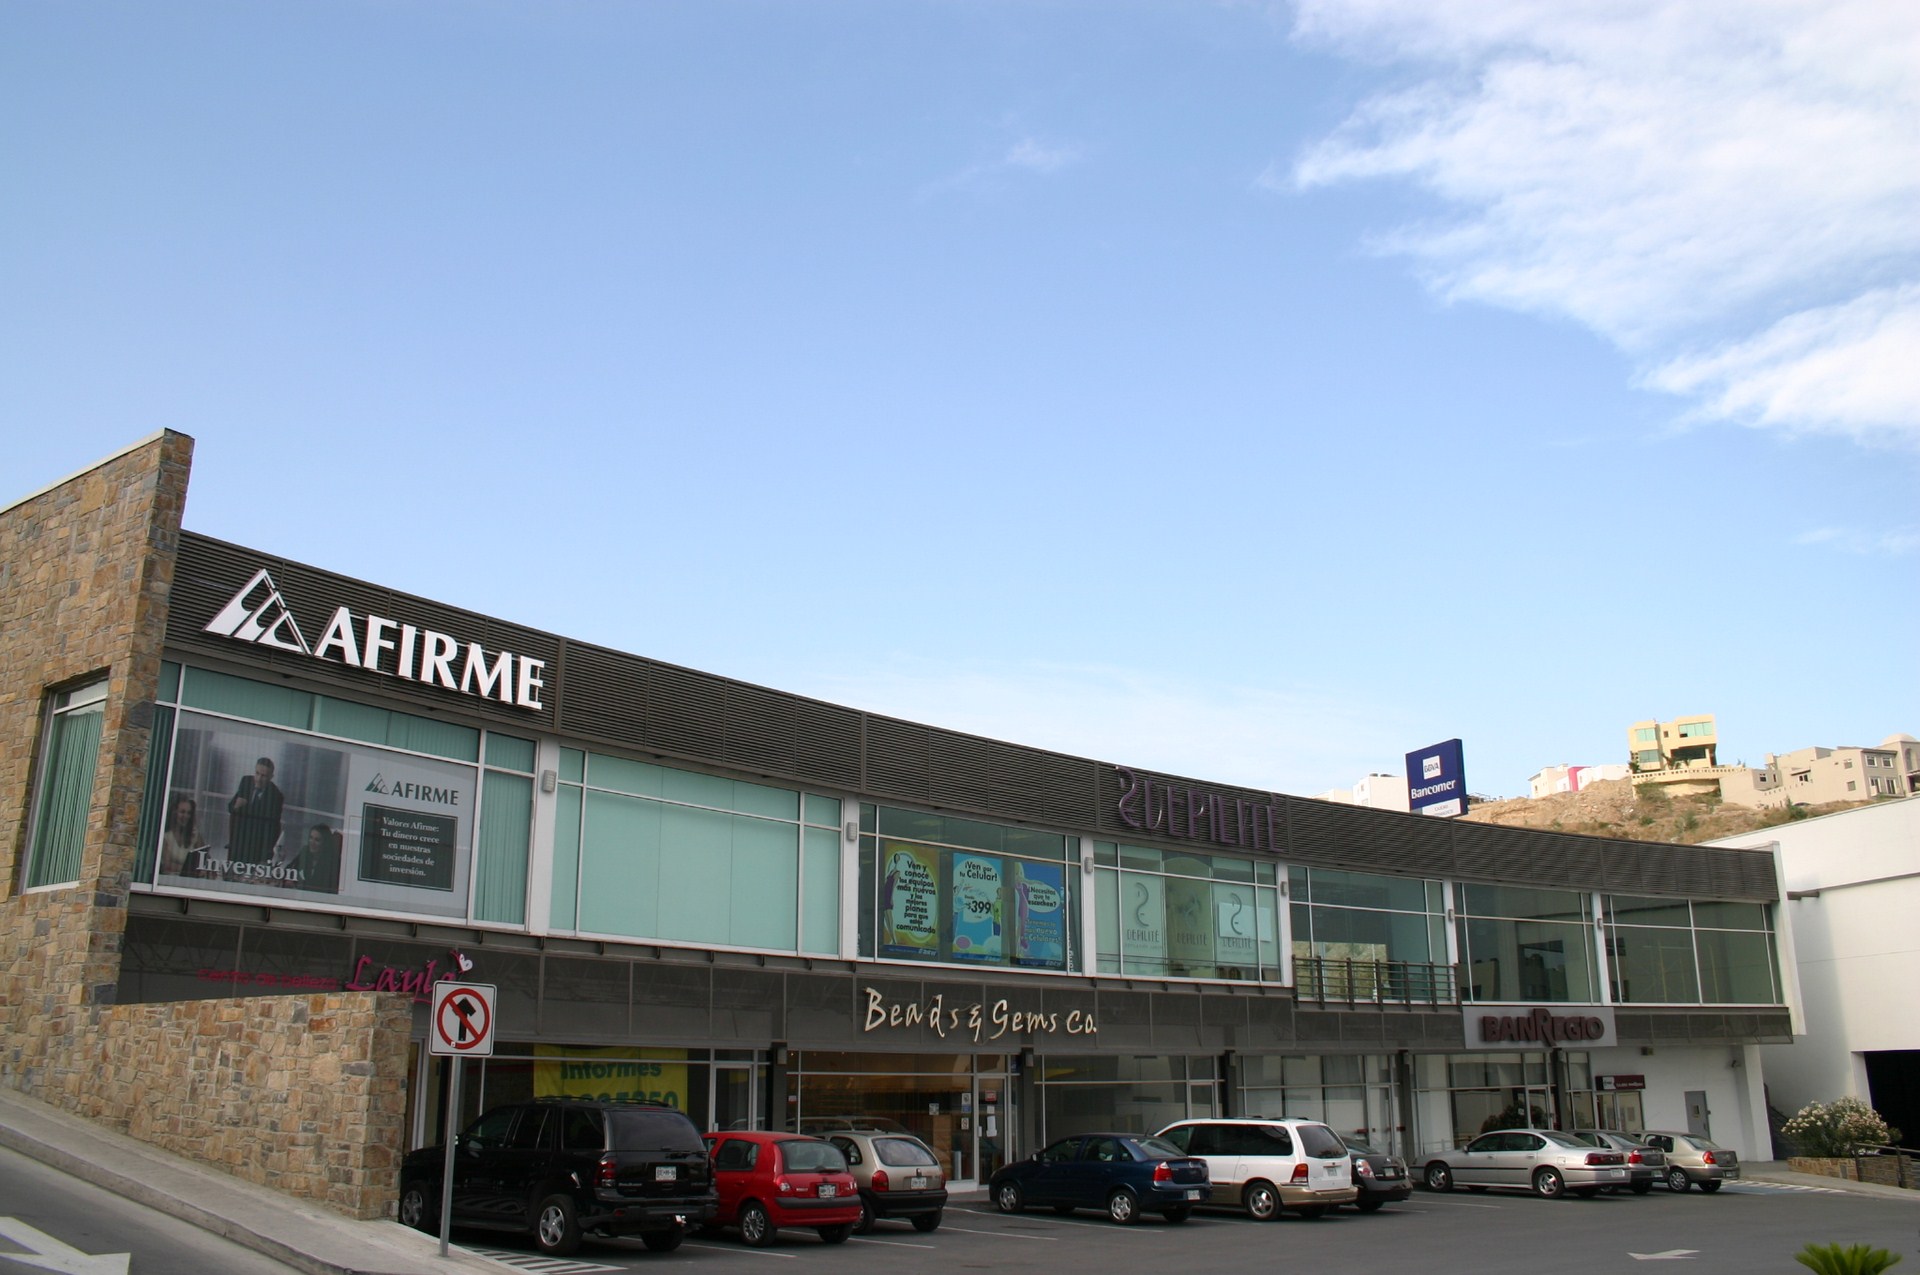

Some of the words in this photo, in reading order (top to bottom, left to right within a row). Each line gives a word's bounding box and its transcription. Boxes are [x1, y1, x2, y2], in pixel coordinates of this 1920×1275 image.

[313, 606, 545, 711] AFIRME
[1424, 762, 1440, 773] BBVA
[391, 781, 459, 805] AFIRME
[1411, 780, 1456, 799] Bancomer
[382, 816, 410, 828] Valores
[410, 820, 440, 833] Afirme:
[381, 828, 391, 837] Tu
[392, 830, 418, 841] dinero
[419, 835, 440, 844] crece
[399, 844, 431, 854] nuestras
[196, 850, 299, 882] Inversión
[382, 853, 424, 865] sociedades
[425, 858, 435, 867] de
[907, 860, 921, 870] Ven
[922, 864, 928, 872] y
[964, 861, 981, 870] ¡Ven
[389, 864, 426, 876] inversión.
[904, 870, 929, 880] conoce
[966, 870, 998, 882] Celular!
[908, 878, 934, 888] equipos
[897, 884, 911, 892] más
[913, 886, 936, 896] nuevos
[905, 904, 928, 914] planes
[906, 899, 927, 907] mejores
[1028, 900, 1057, 908] escuchen?
[904, 911, 917, 919] para
[896, 923, 936, 935] comunicado
[864, 987, 960, 1038] Beads
[990, 999, 1057, 1040] Gems
[1066, 1009, 1097, 1034] Co.
[560, 1061, 662, 1080] Informes
